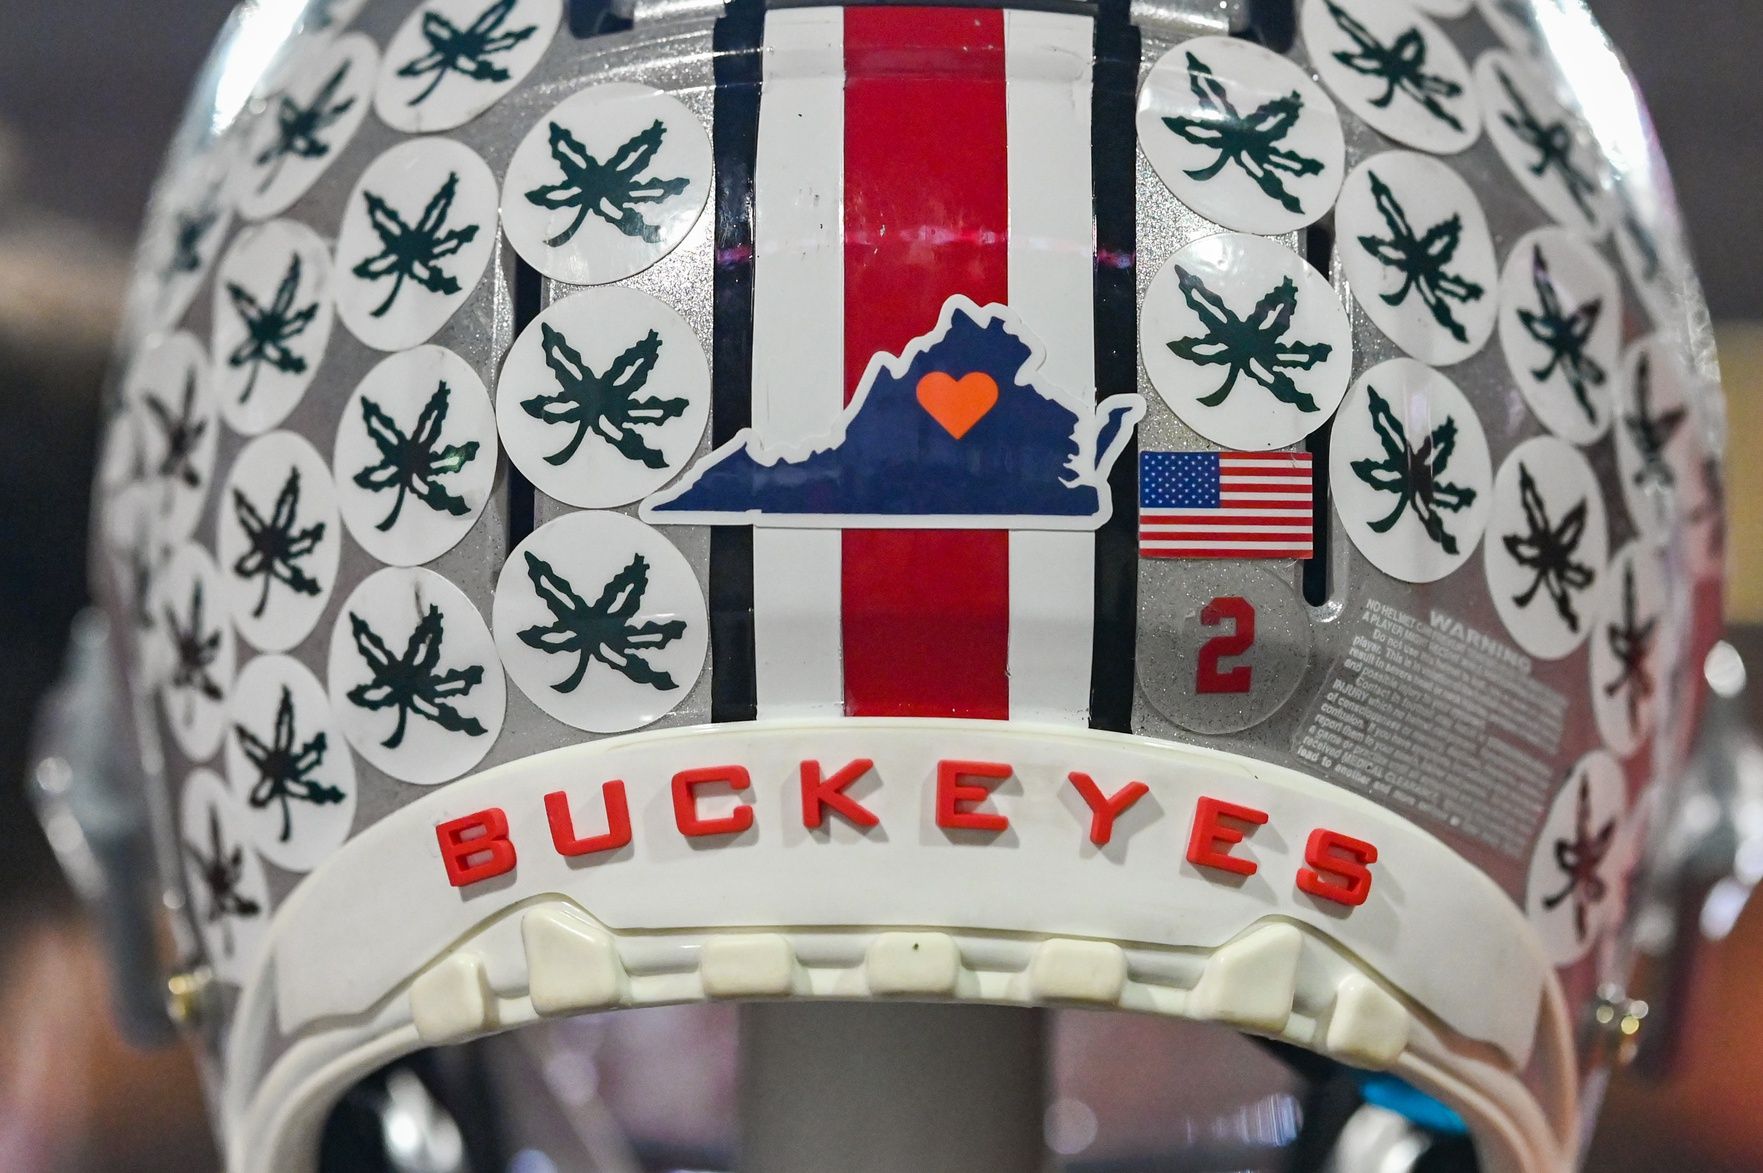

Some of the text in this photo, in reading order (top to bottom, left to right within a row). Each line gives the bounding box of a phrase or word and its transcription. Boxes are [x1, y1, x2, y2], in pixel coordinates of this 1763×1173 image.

[1196, 596, 1255, 694] 2
[1429, 608, 1531, 676] WARNING
[1332, 679, 1369, 701] INJURY
[436, 760, 1377, 906] BUCKEYES
